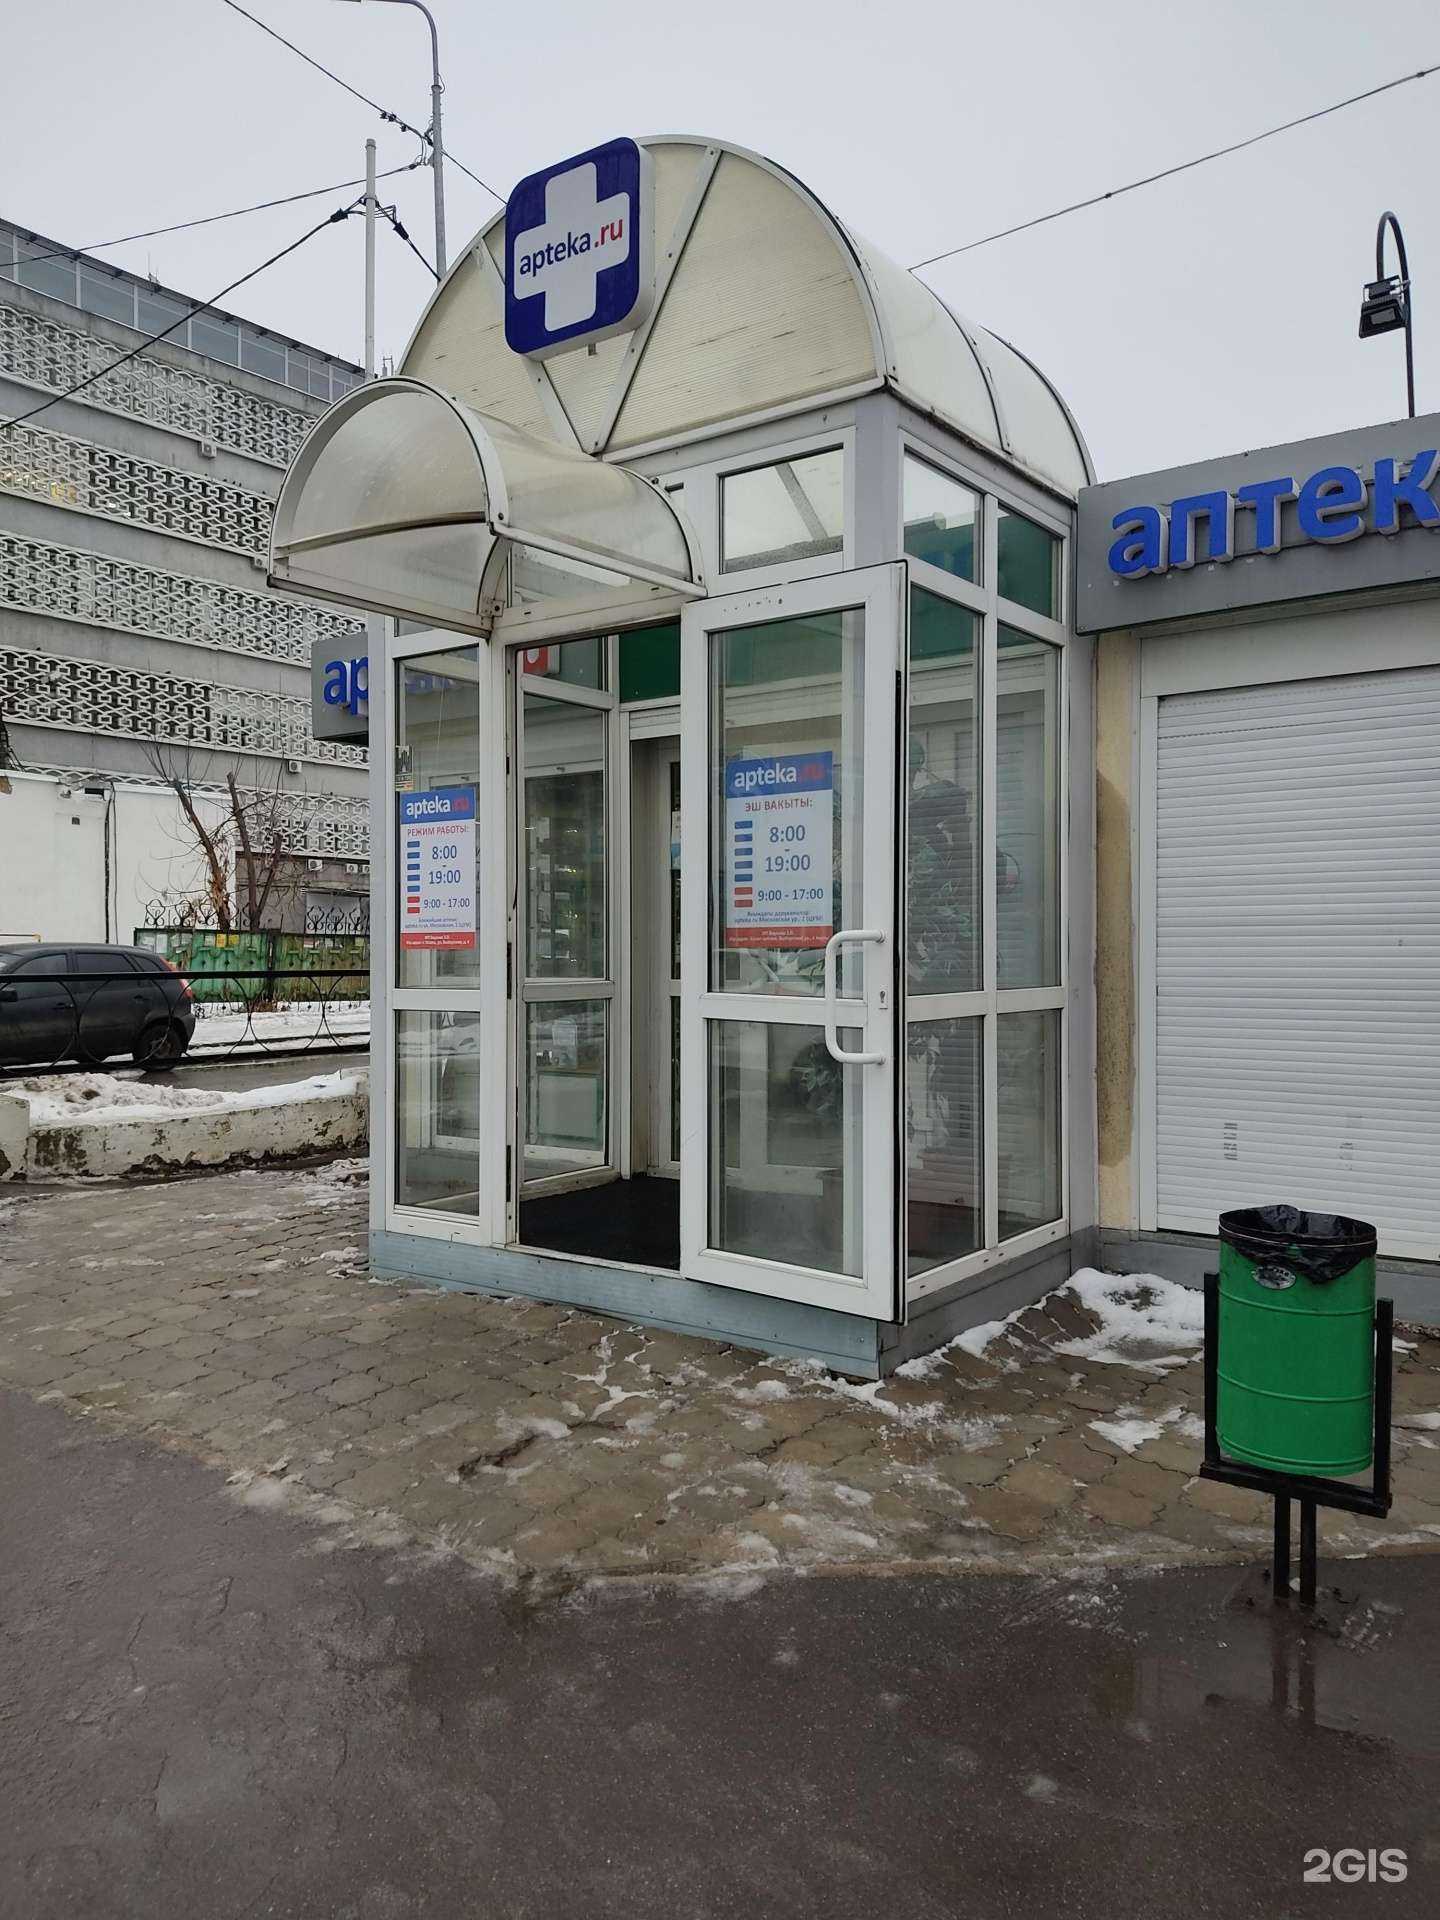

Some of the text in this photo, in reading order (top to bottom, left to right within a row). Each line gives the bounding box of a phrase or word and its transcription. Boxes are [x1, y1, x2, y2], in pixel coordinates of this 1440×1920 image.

[519, 218, 623, 277] apteka.ru
[1108, 450, 1440, 580] аптек
[745, 798, 813, 811] ЭШ ВАКЫТЫ:
[407, 827, 435, 836] РЕЖИМ
[769, 824, 806, 843] 8:00
[432, 846, 457, 860] 8:00
[765, 854, 811, 873] 19:00
[428, 870, 461, 884] 19:00
[758, 889, 782, 901] 9:00
[792, 888, 824, 900] 17:00
[423, 899, 441, 909] 9:00
[448, 898, 470, 908] 17:00
